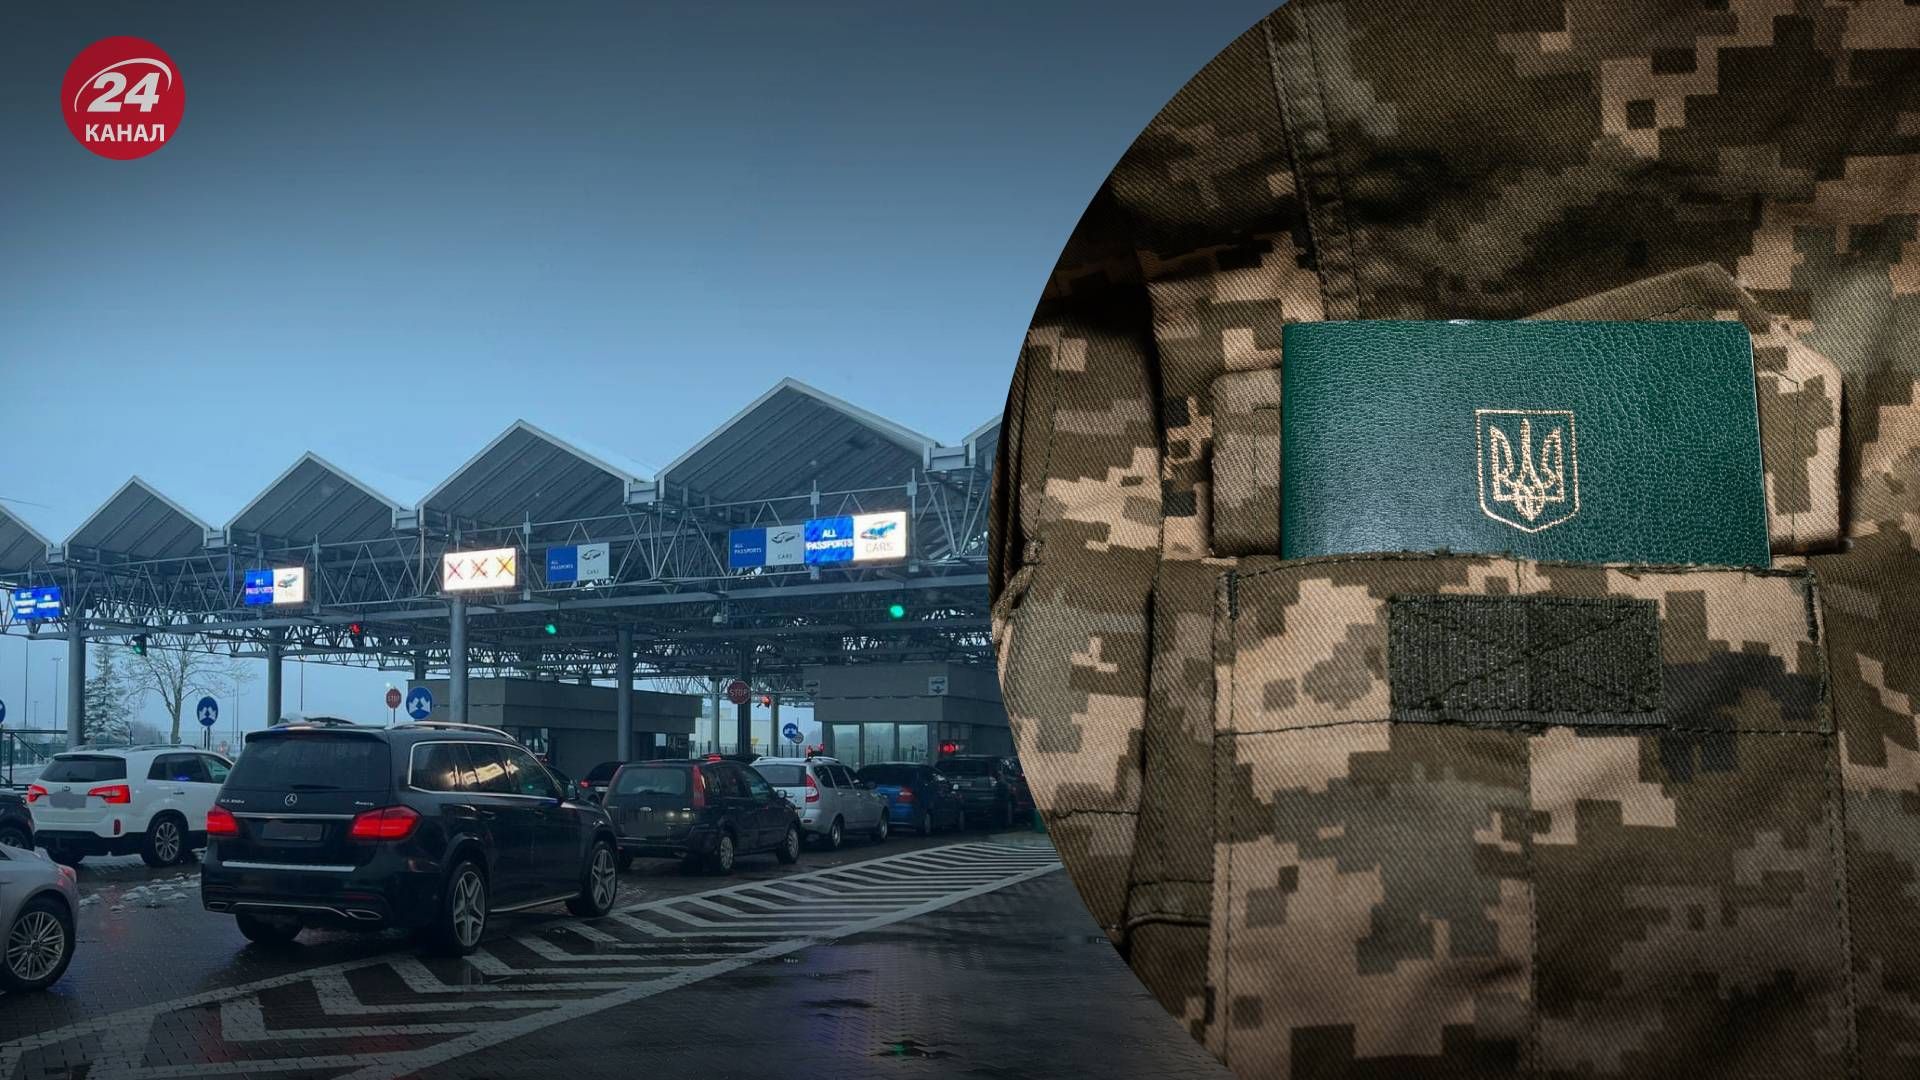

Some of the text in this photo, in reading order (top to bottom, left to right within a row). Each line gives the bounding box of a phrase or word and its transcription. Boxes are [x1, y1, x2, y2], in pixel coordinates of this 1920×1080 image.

[822, 529, 838, 538] ALL
[805, 539, 853, 550] PASSPORTS
[865, 543, 895, 553] CARS
